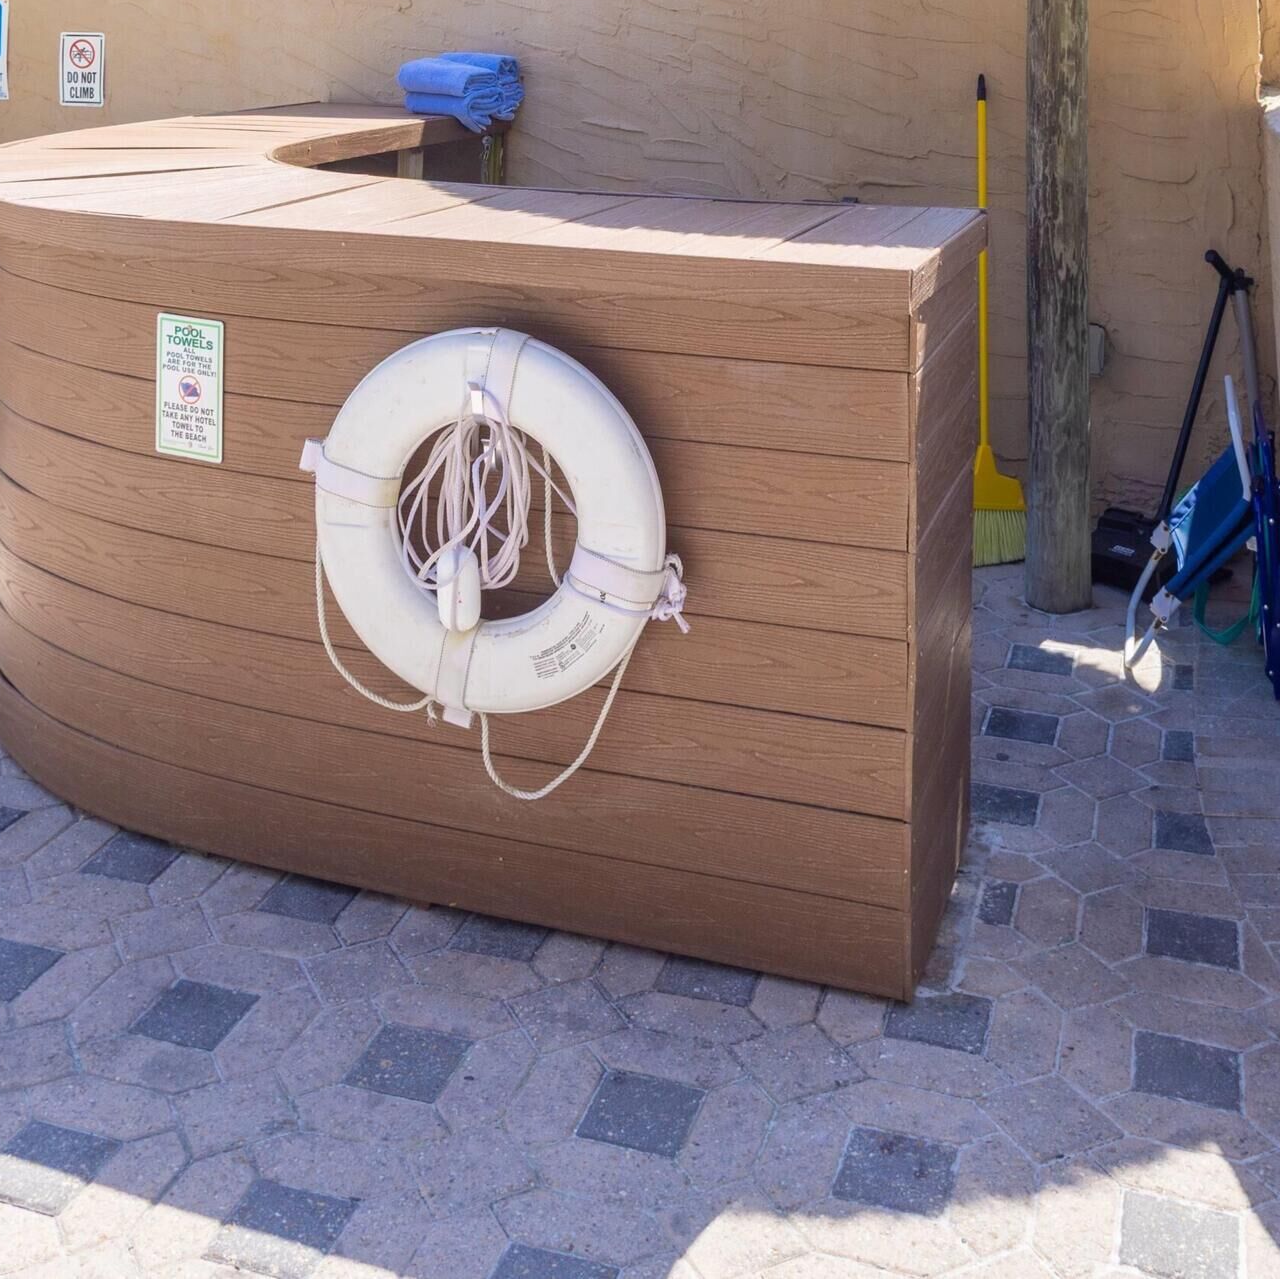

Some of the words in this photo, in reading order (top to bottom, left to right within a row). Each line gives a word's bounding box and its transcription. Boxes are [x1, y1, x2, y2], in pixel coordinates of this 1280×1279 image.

[67, 71, 79, 84] DO
[81, 71, 97, 84] NOT
[69, 86, 95, 99] CLIMB
[174, 325, 206, 340] POOL
[166, 334, 214, 350] TOWELS
[166, 351, 185, 359] POOL
[186, 354, 213, 363] TOWELS
[163, 363, 180, 372] POOL
[197, 369, 216, 377] ONLY!
[198, 362, 211, 370] THE
[163, 401, 188, 412] PLEASE
[189, 405, 199, 414] DO
[200, 407, 214, 416] NOT
[162, 410, 178, 420] TAKE
[180, 413, 193, 422] ANY
[195, 416, 216, 426] HOTEL
[172, 420, 194, 431] TOWEL
[195, 424, 204, 433] TO
[171, 429, 183, 438] THE
[185, 432, 207, 442] BEACH
